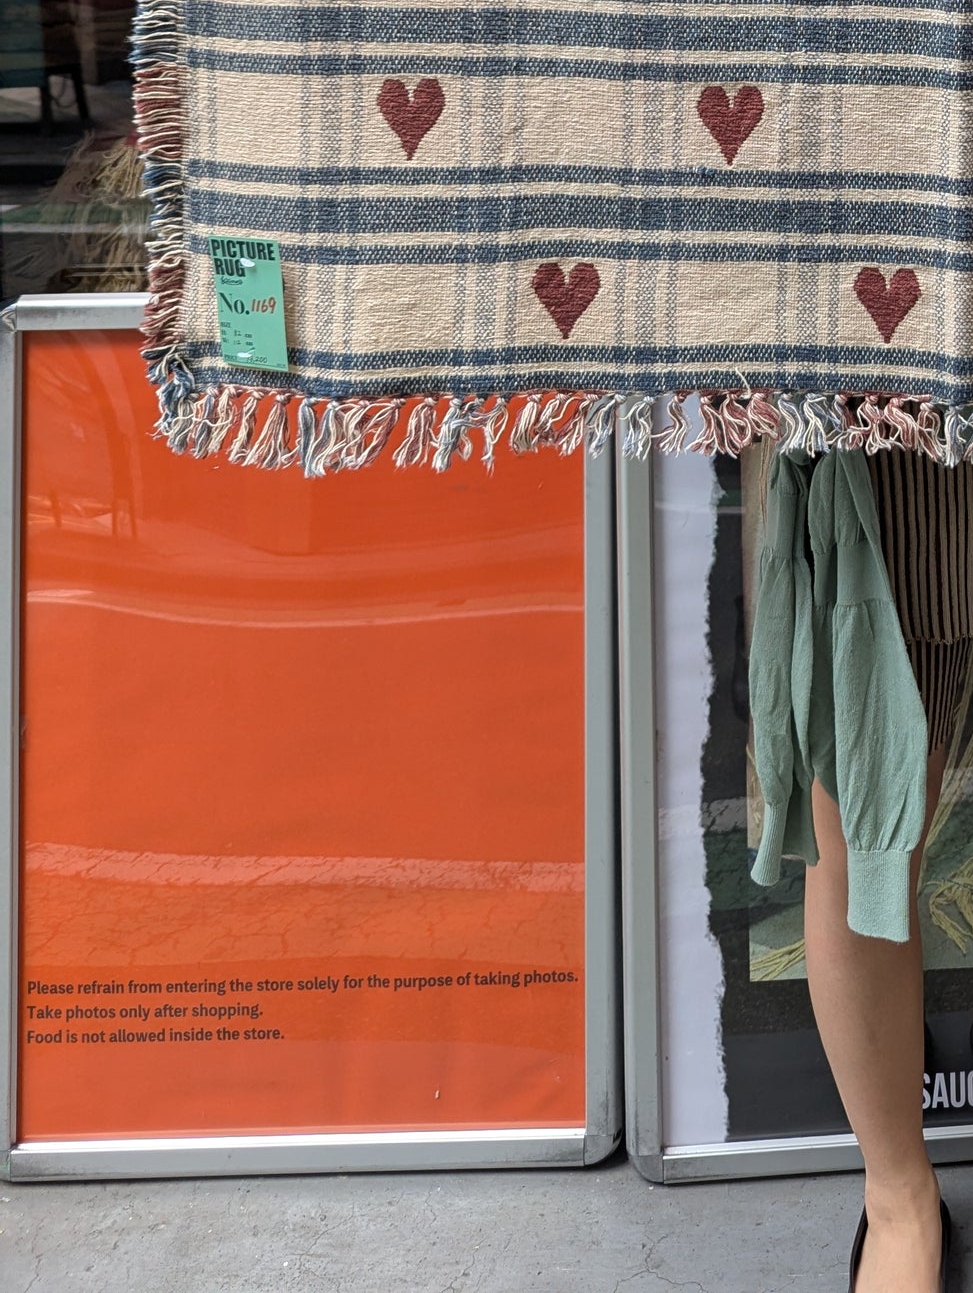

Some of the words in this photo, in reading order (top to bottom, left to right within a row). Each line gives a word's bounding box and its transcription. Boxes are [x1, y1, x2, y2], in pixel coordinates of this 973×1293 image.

[210, 238, 276, 261] PICTURE
[213, 257, 246, 277] RUG
[219, 292, 250, 315] No.
[251, 296, 277, 314] 1169
[27, 981, 74, 994] Please
[77, 980, 124, 994] refrain
[128, 980, 162, 994] from
[166, 979, 227, 996] entering
[229, 978, 253, 992] the
[256, 979, 293, 992] store
[297, 976, 340, 993] solely
[343, 975, 363, 989] for
[367, 974, 390, 988] the
[394, 975, 453, 991] purpose
[456, 972, 472, 987] of
[474, 971, 520, 988] taking
[523, 970, 579, 987] photos.
[27, 1005, 62, 1019] Take
[65, 1004, 116, 1022] photos
[119, 1005, 150, 1022] only
[154, 1004, 189, 1018] after
[191, 1003, 263, 1021] shopping.
[26, 1029, 62, 1044] Food
[66, 1029, 78, 1043] is
[82, 1029, 105, 1043] not
[109, 1028, 166, 1043] allowed
[169, 1027, 213, 1042] inside
[216, 1026, 240, 1041] the
[243, 1027, 285, 1040] store.
